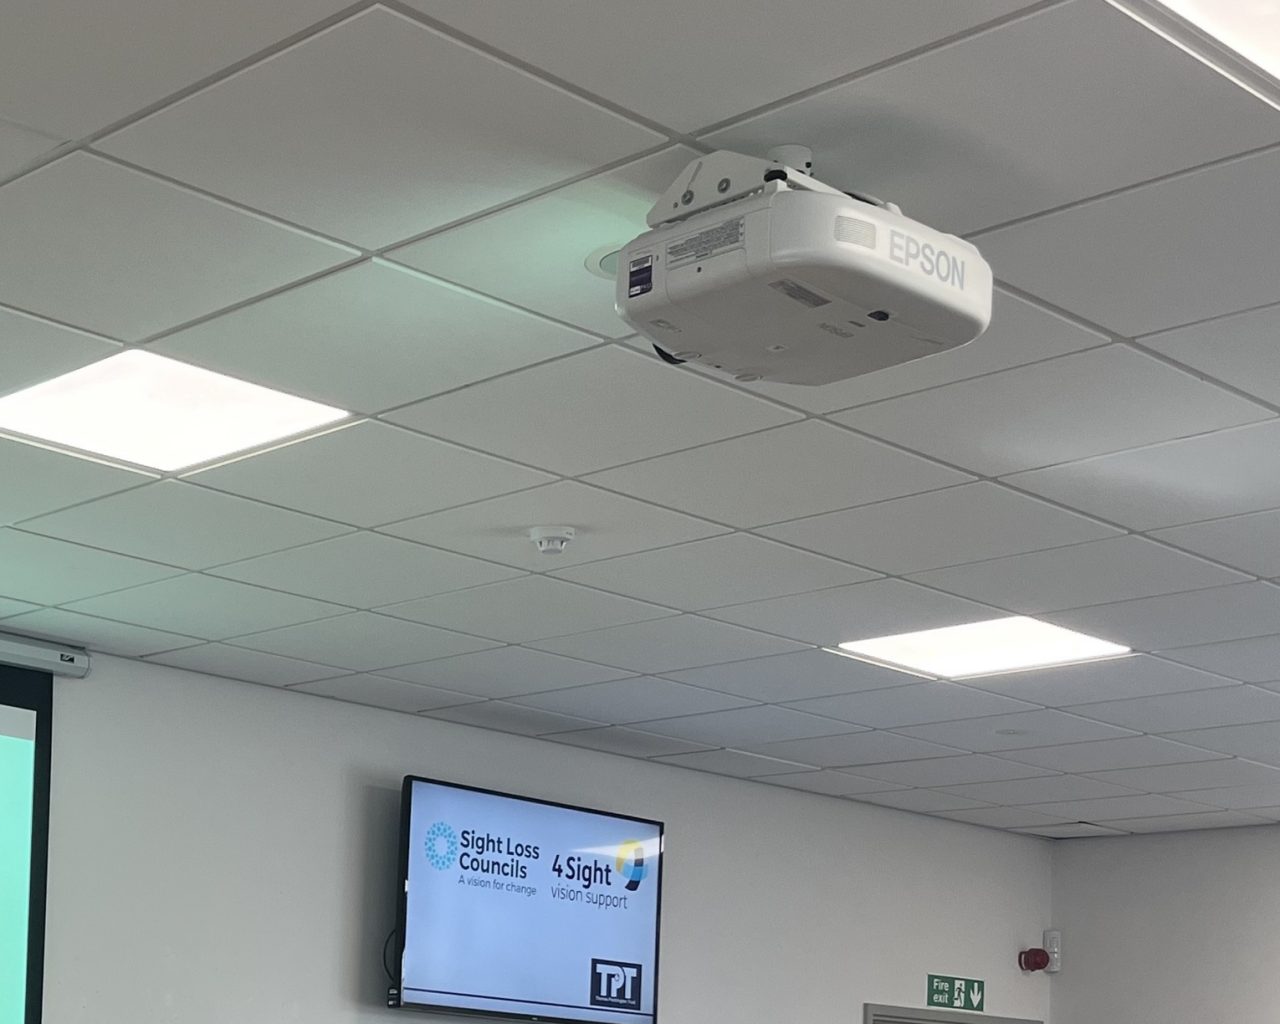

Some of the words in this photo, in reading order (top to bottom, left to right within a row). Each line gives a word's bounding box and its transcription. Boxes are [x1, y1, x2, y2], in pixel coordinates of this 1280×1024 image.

[889, 229, 965, 291] EPSON
[460, 830, 503, 855] Sight
[506, 837, 540, 860] Loss
[459, 852, 527, 879] Councils
[458, 874, 466, 885] A
[467, 876, 491, 889] vision
[493, 878, 504, 890] for
[505, 882, 537, 897] change
[551, 883, 583, 901] vision
[585, 892, 628, 909] support
[596, 963, 637, 999] TPT
[933, 978, 950, 991] Fire
[933, 993, 949, 1004] exit
